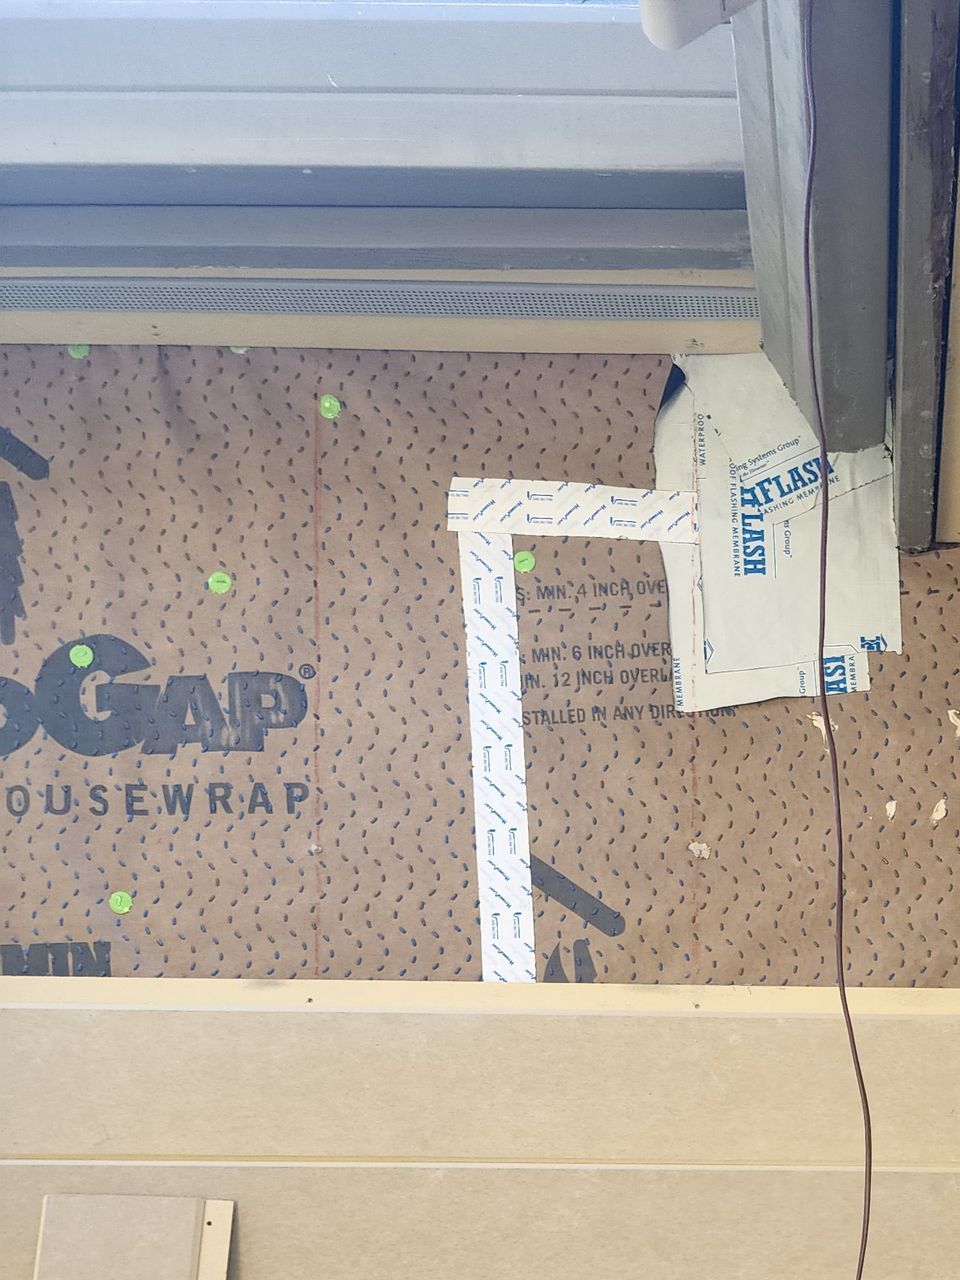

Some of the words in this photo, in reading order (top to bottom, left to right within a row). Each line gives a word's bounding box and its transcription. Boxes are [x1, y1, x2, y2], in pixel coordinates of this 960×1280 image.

[747, 448, 777, 467] Systems
[731, 526, 741, 577] MEMBRANE
[577, 582, 588, 598] 4
[572, 645, 582, 661] 6
[552, 671, 571, 688] 12
[613, 705, 645, 721] ANY
